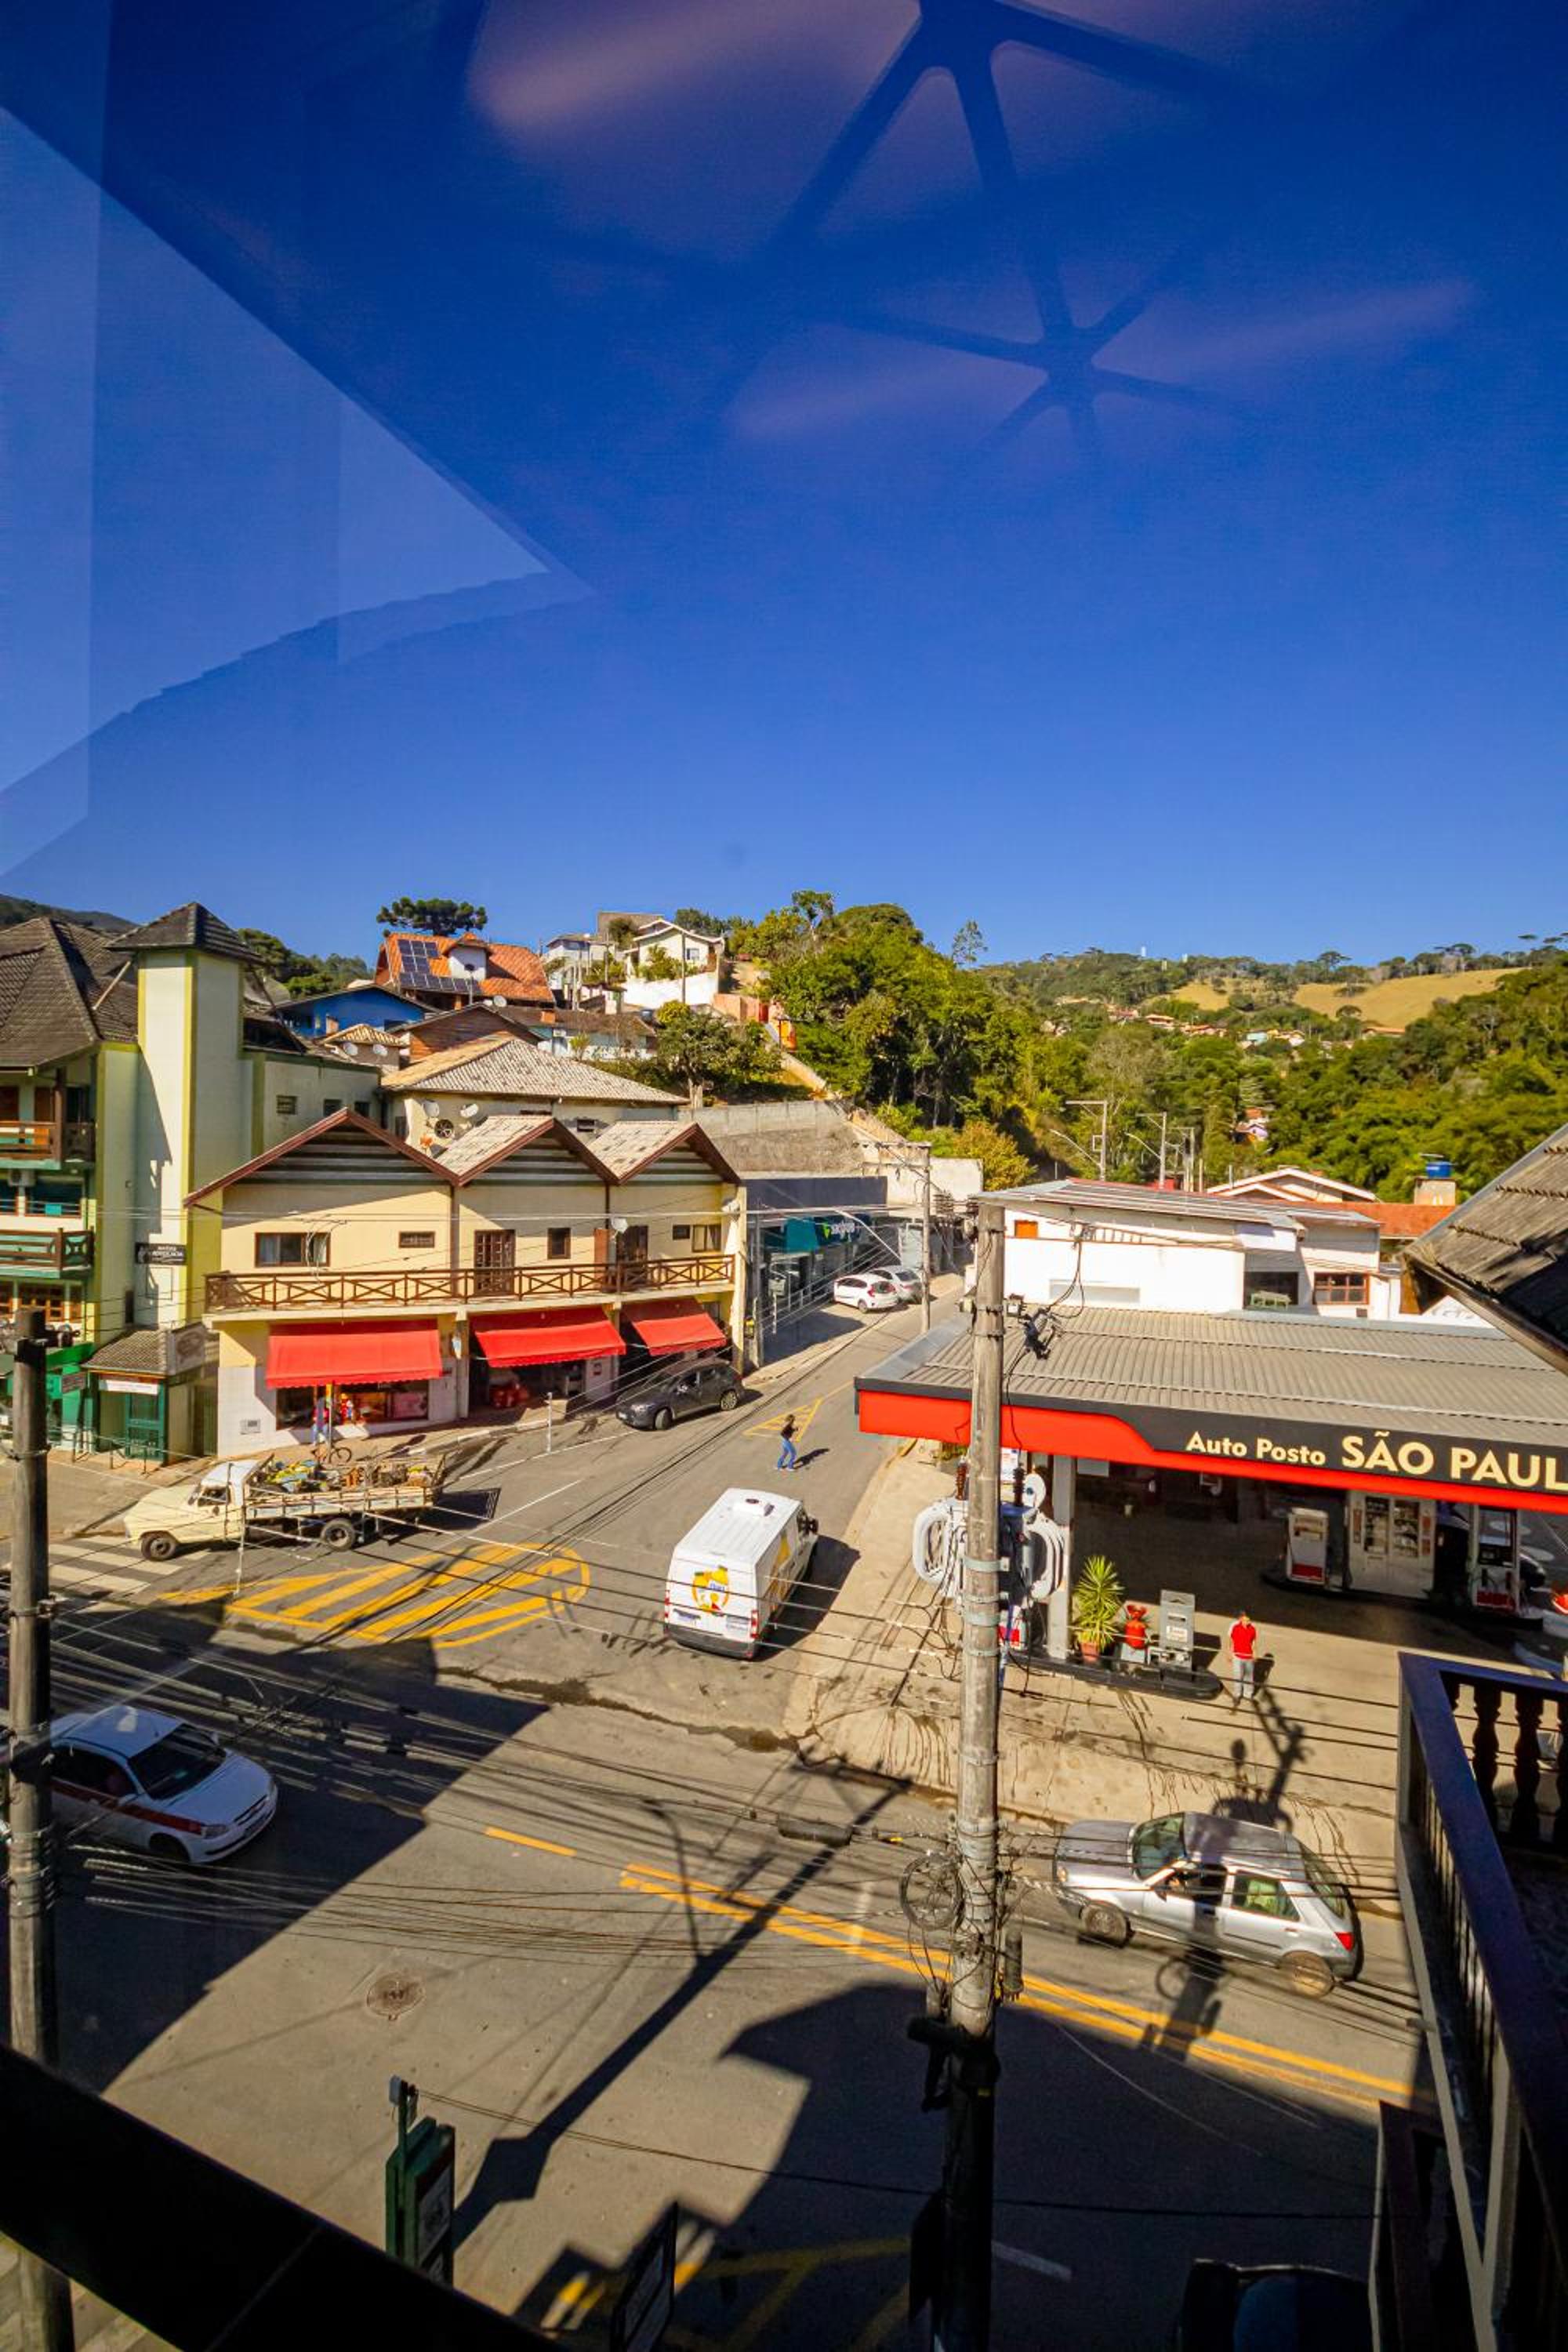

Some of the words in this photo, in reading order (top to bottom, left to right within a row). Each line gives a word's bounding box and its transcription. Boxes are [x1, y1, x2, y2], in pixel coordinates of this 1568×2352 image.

[1185, 1431, 1247, 1457] Auto
[1257, 1438, 1326, 1465] Posto
[1341, 1431, 1434, 1475] SÃO
[1450, 1448, 1568, 1491] PAUL
